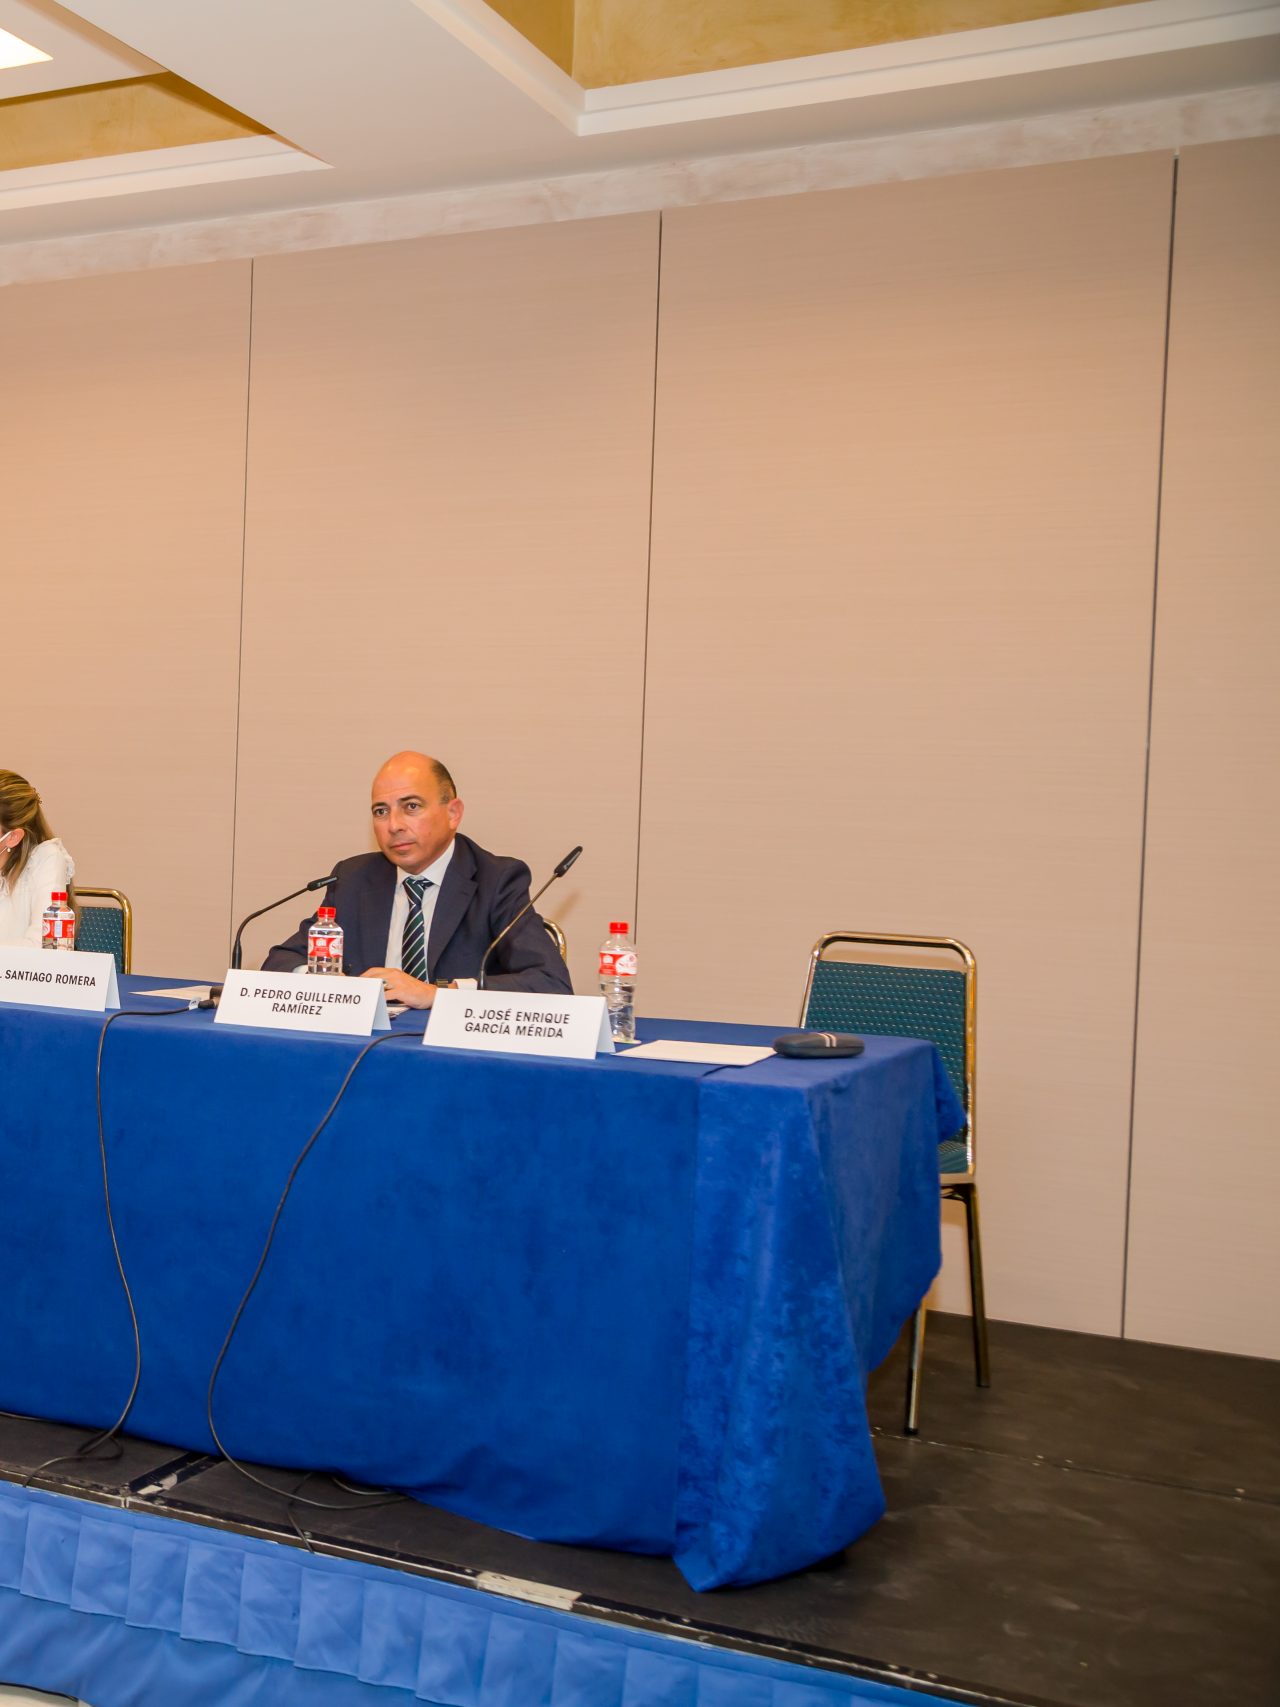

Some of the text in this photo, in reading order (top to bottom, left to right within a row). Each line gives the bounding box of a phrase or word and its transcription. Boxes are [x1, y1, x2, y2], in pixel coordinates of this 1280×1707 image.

[4, 969, 52, 982] SANTIAGO
[55, 973, 96, 986] ROMERA
[240, 987, 361, 1004] D. PEDRO GUILLERMO
[271, 1002, 323, 1015] RAMÍREZ
[464, 1008, 570, 1024] D. JOSÉ ENRIQUE
[465, 1022, 563, 1038] GARCÍA MÉRIDA
